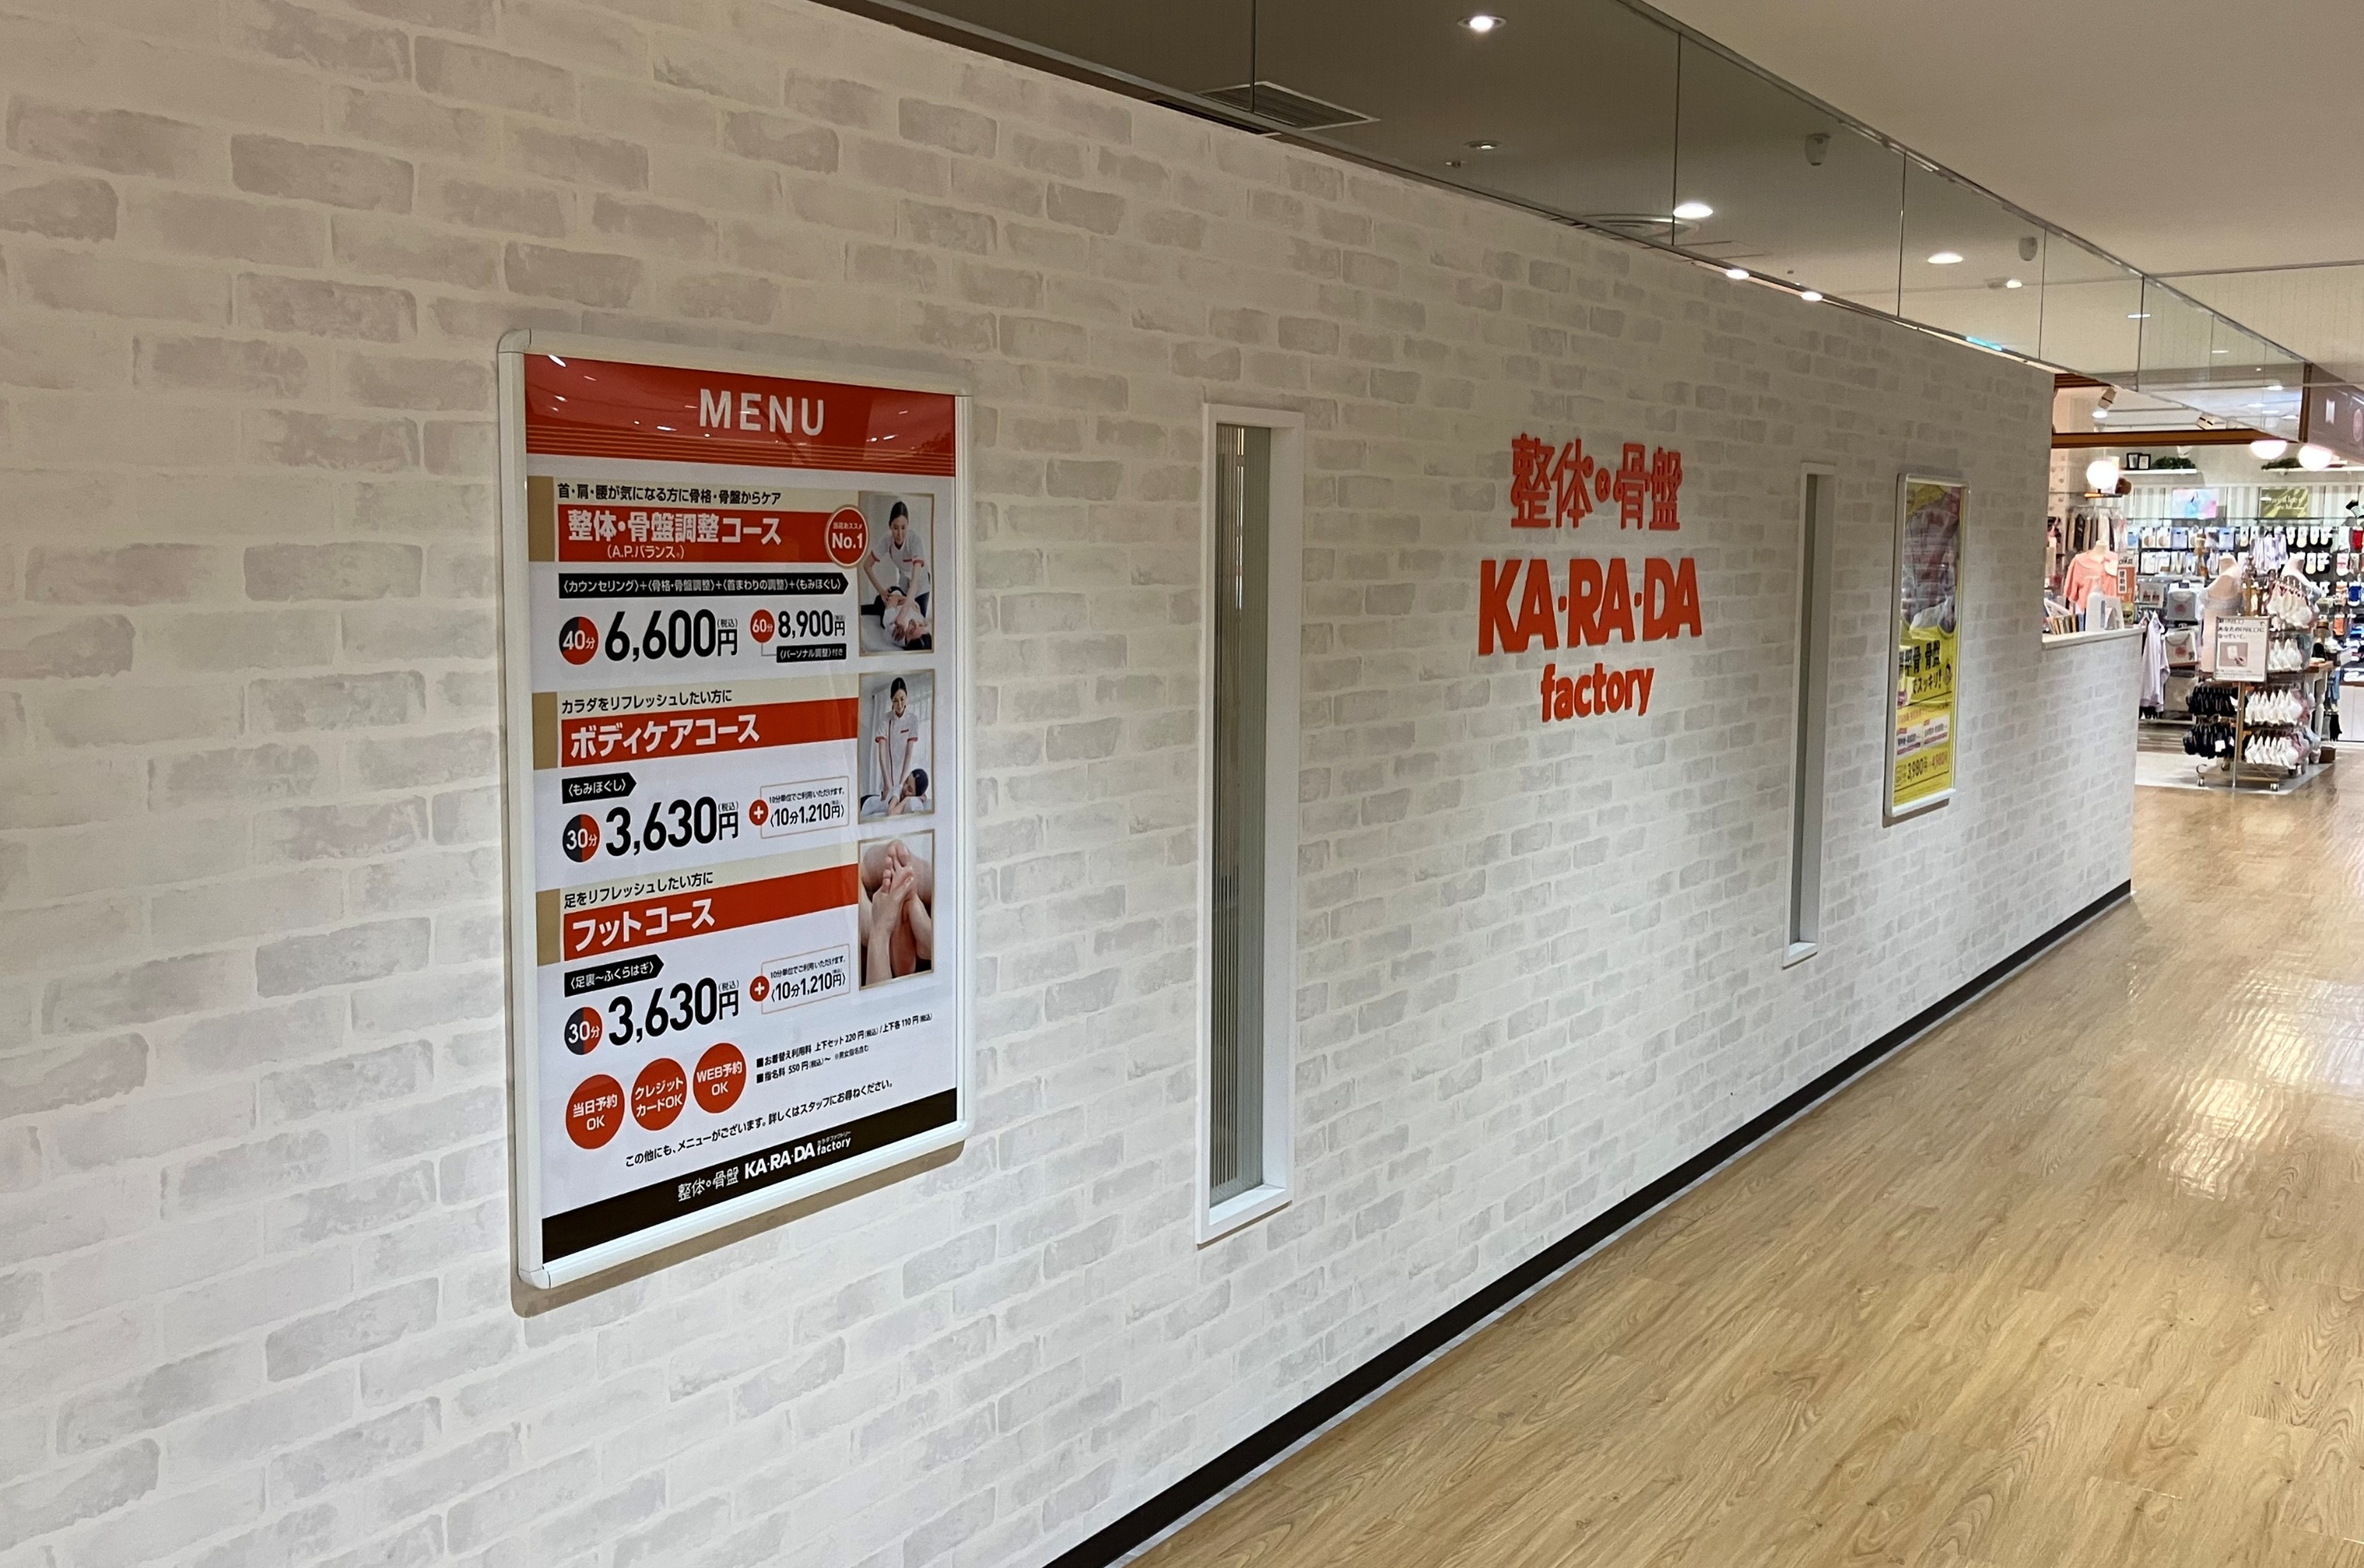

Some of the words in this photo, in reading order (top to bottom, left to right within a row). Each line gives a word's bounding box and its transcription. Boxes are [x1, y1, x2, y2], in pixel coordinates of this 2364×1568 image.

[699, 389, 824, 436] MENU
[558, 483, 781, 505] 首・肩・腰が気になる方に骨格・骨盤からケア
[567, 509, 782, 545] 整体・骨盤調整コース
[832, 532, 863, 550] No.1
[717, 618, 738, 628] (税込)
[752, 619, 774, 633] 60分
[778, 609, 846, 639] 8,900円
[562, 629, 595, 650] 40分
[604, 609, 738, 662] 6,600円
[562, 689, 732, 714] カラダをリフレッシュしたい方に
[1541, 663, 1654, 722] factory
[571, 713, 760, 758] ボディケアコース
[718, 801, 739, 812] (税込)
[606, 796, 738, 856] 3,630円
[565, 828, 597, 850] 30分
[564, 871, 714, 909] 足をリフレッシュしたい方に
[572, 898, 715, 952] フットコース
[718, 980, 740, 992] (税込)
[608, 977, 739, 1046] 3,630円
[567, 1020, 601, 1044] 30分
[696, 1061, 743, 1083] WEB予約
[634, 1076, 684, 1100] クレジット
[711, 1081, 729, 1096] OK
[572, 1093, 618, 1118] 当日予約
[636, 1093, 683, 1117] カードOK
[586, 1115, 606, 1131] OK
[816, 1137, 852, 1156] factory
